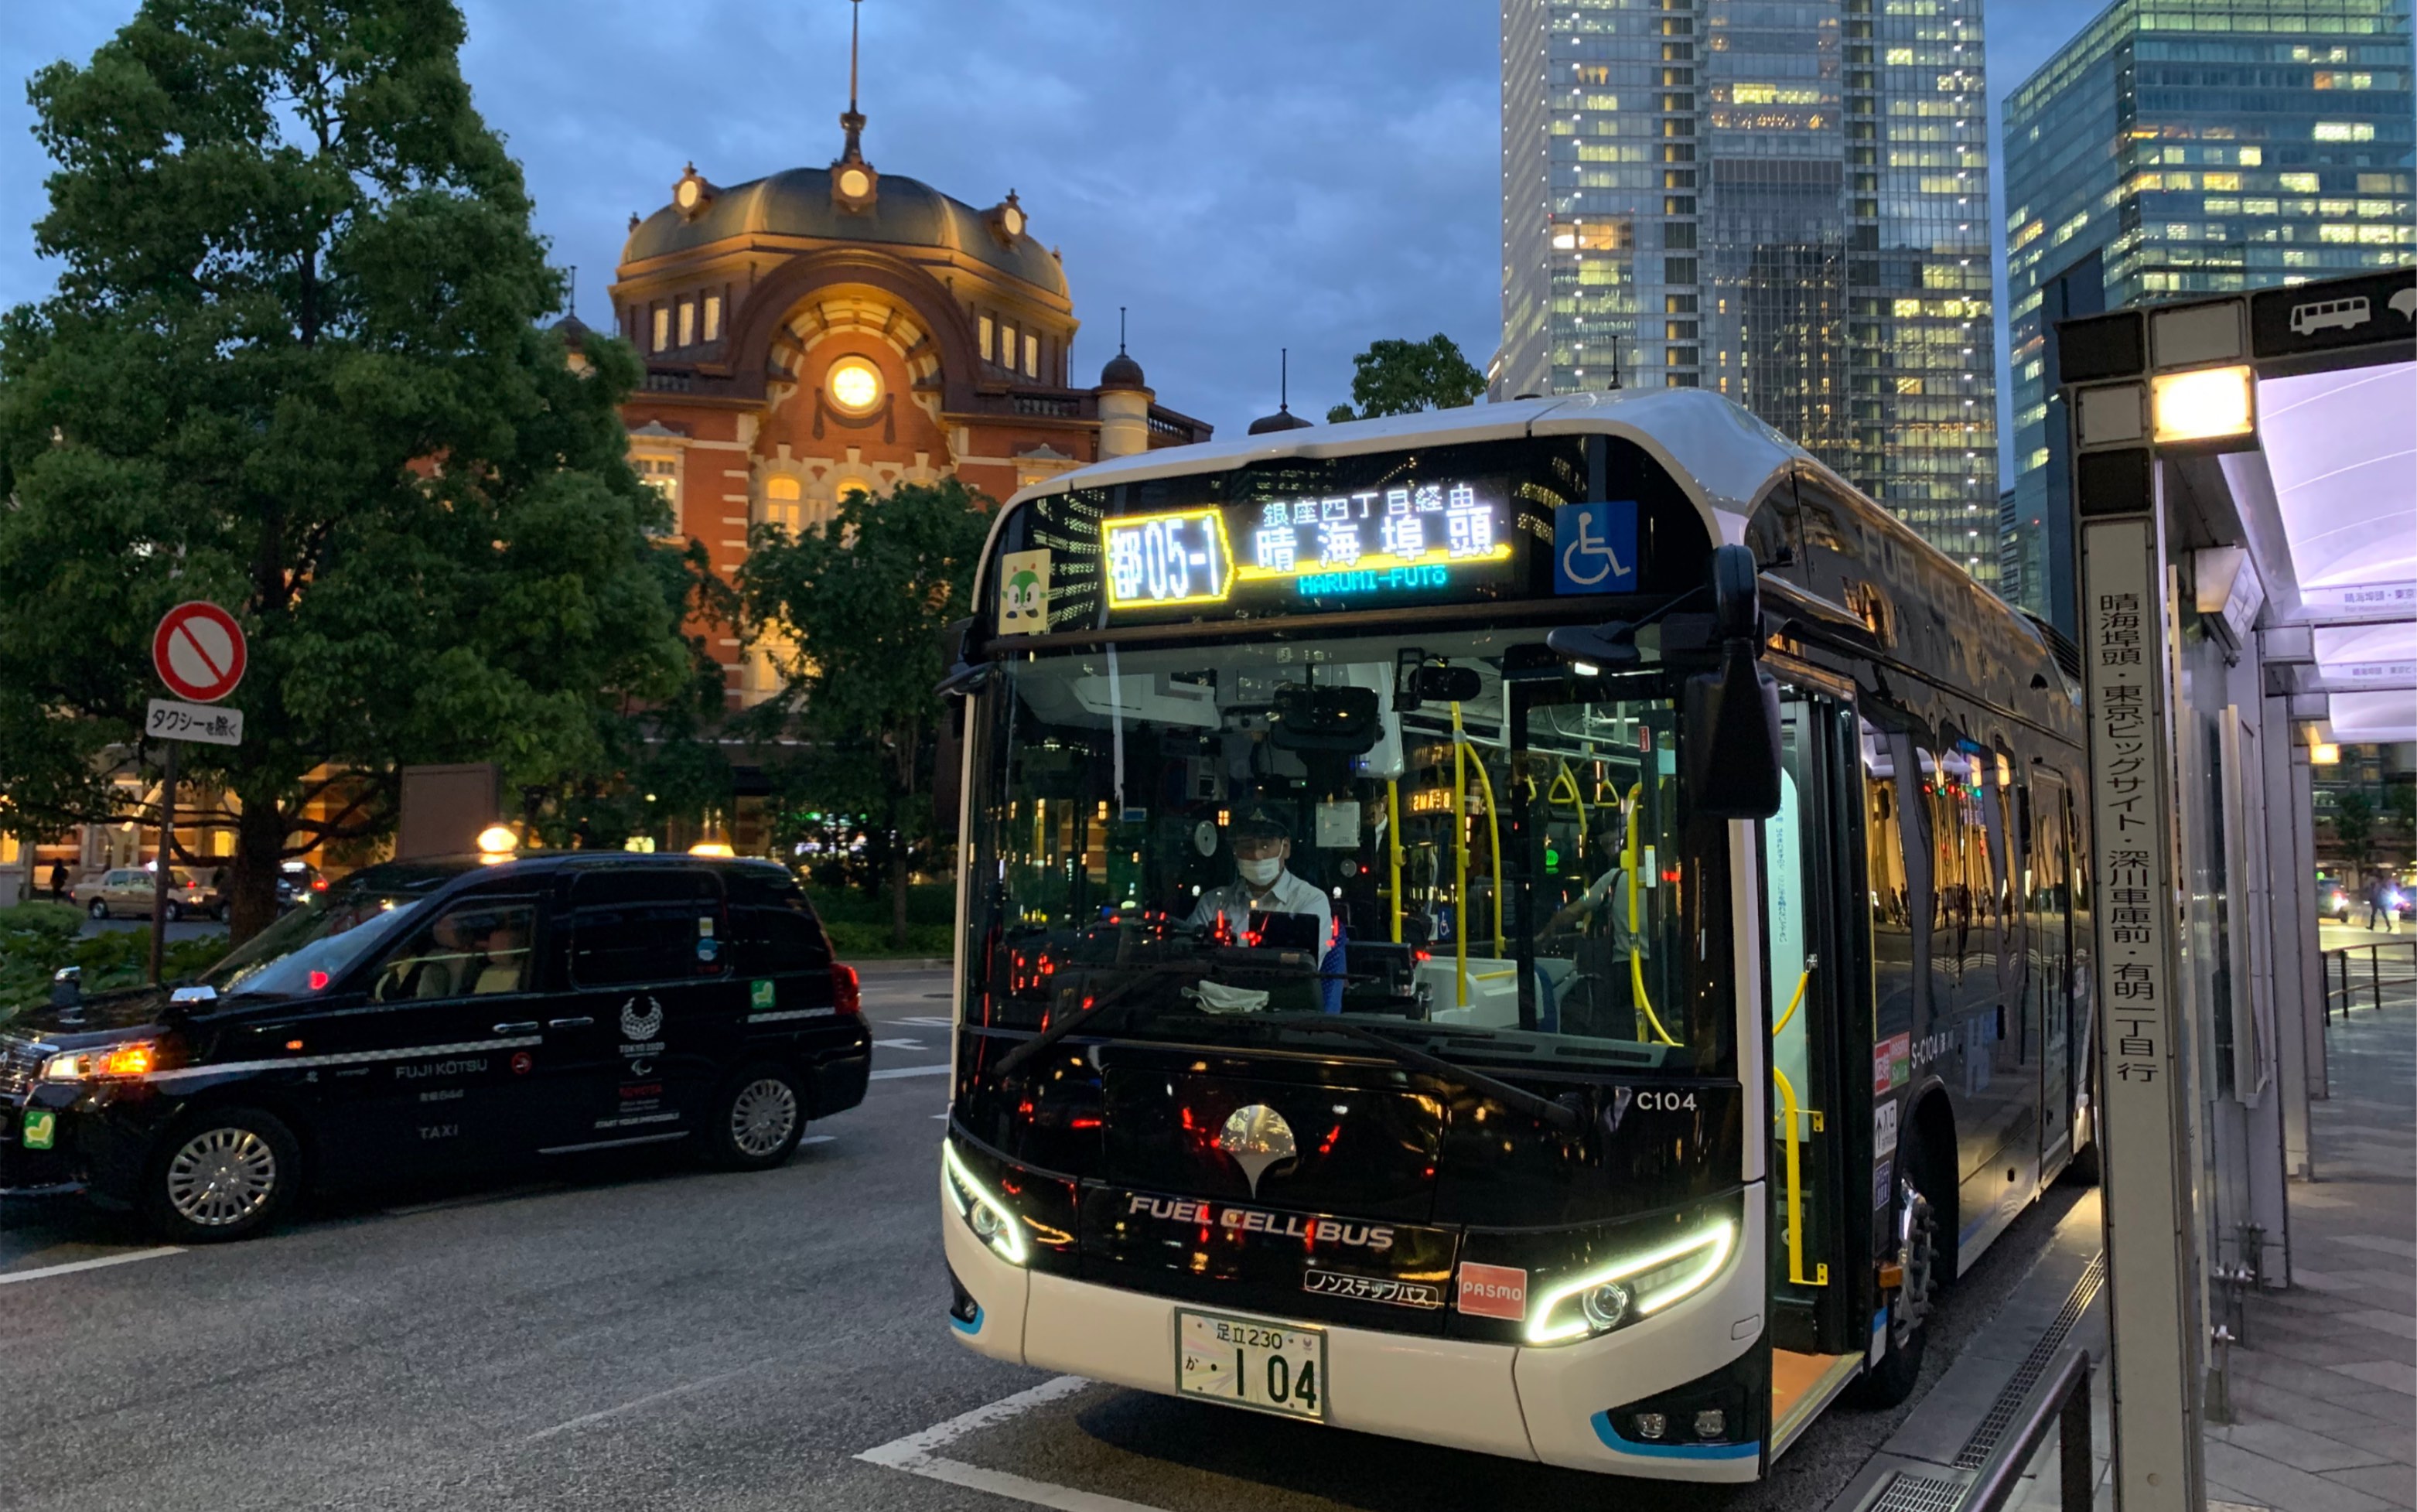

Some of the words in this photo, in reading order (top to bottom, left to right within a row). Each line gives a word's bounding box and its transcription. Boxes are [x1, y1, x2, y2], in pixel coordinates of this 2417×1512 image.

[1263, 483, 1474, 527] 銀座四丁目経由
[1256, 506, 1494, 572] 晴海埠頭
[1109, 515, 1220, 601] 都05-1
[152, 708, 237, 737] タクシーを除く
[395, 1063, 433, 1079] FUJI
[1637, 1091, 1698, 1111] C104
[418, 1124, 459, 1141] TAXI
[1128, 1196, 1214, 1227] FUEL
[1220, 1208, 1306, 1237] CELL
[1314, 1221, 1395, 1250] BUS
[1313, 1273, 1429, 1305] ノンステップバス
[1463, 1282, 1523, 1302] PASMO
[1185, 1355, 1199, 1371] か
